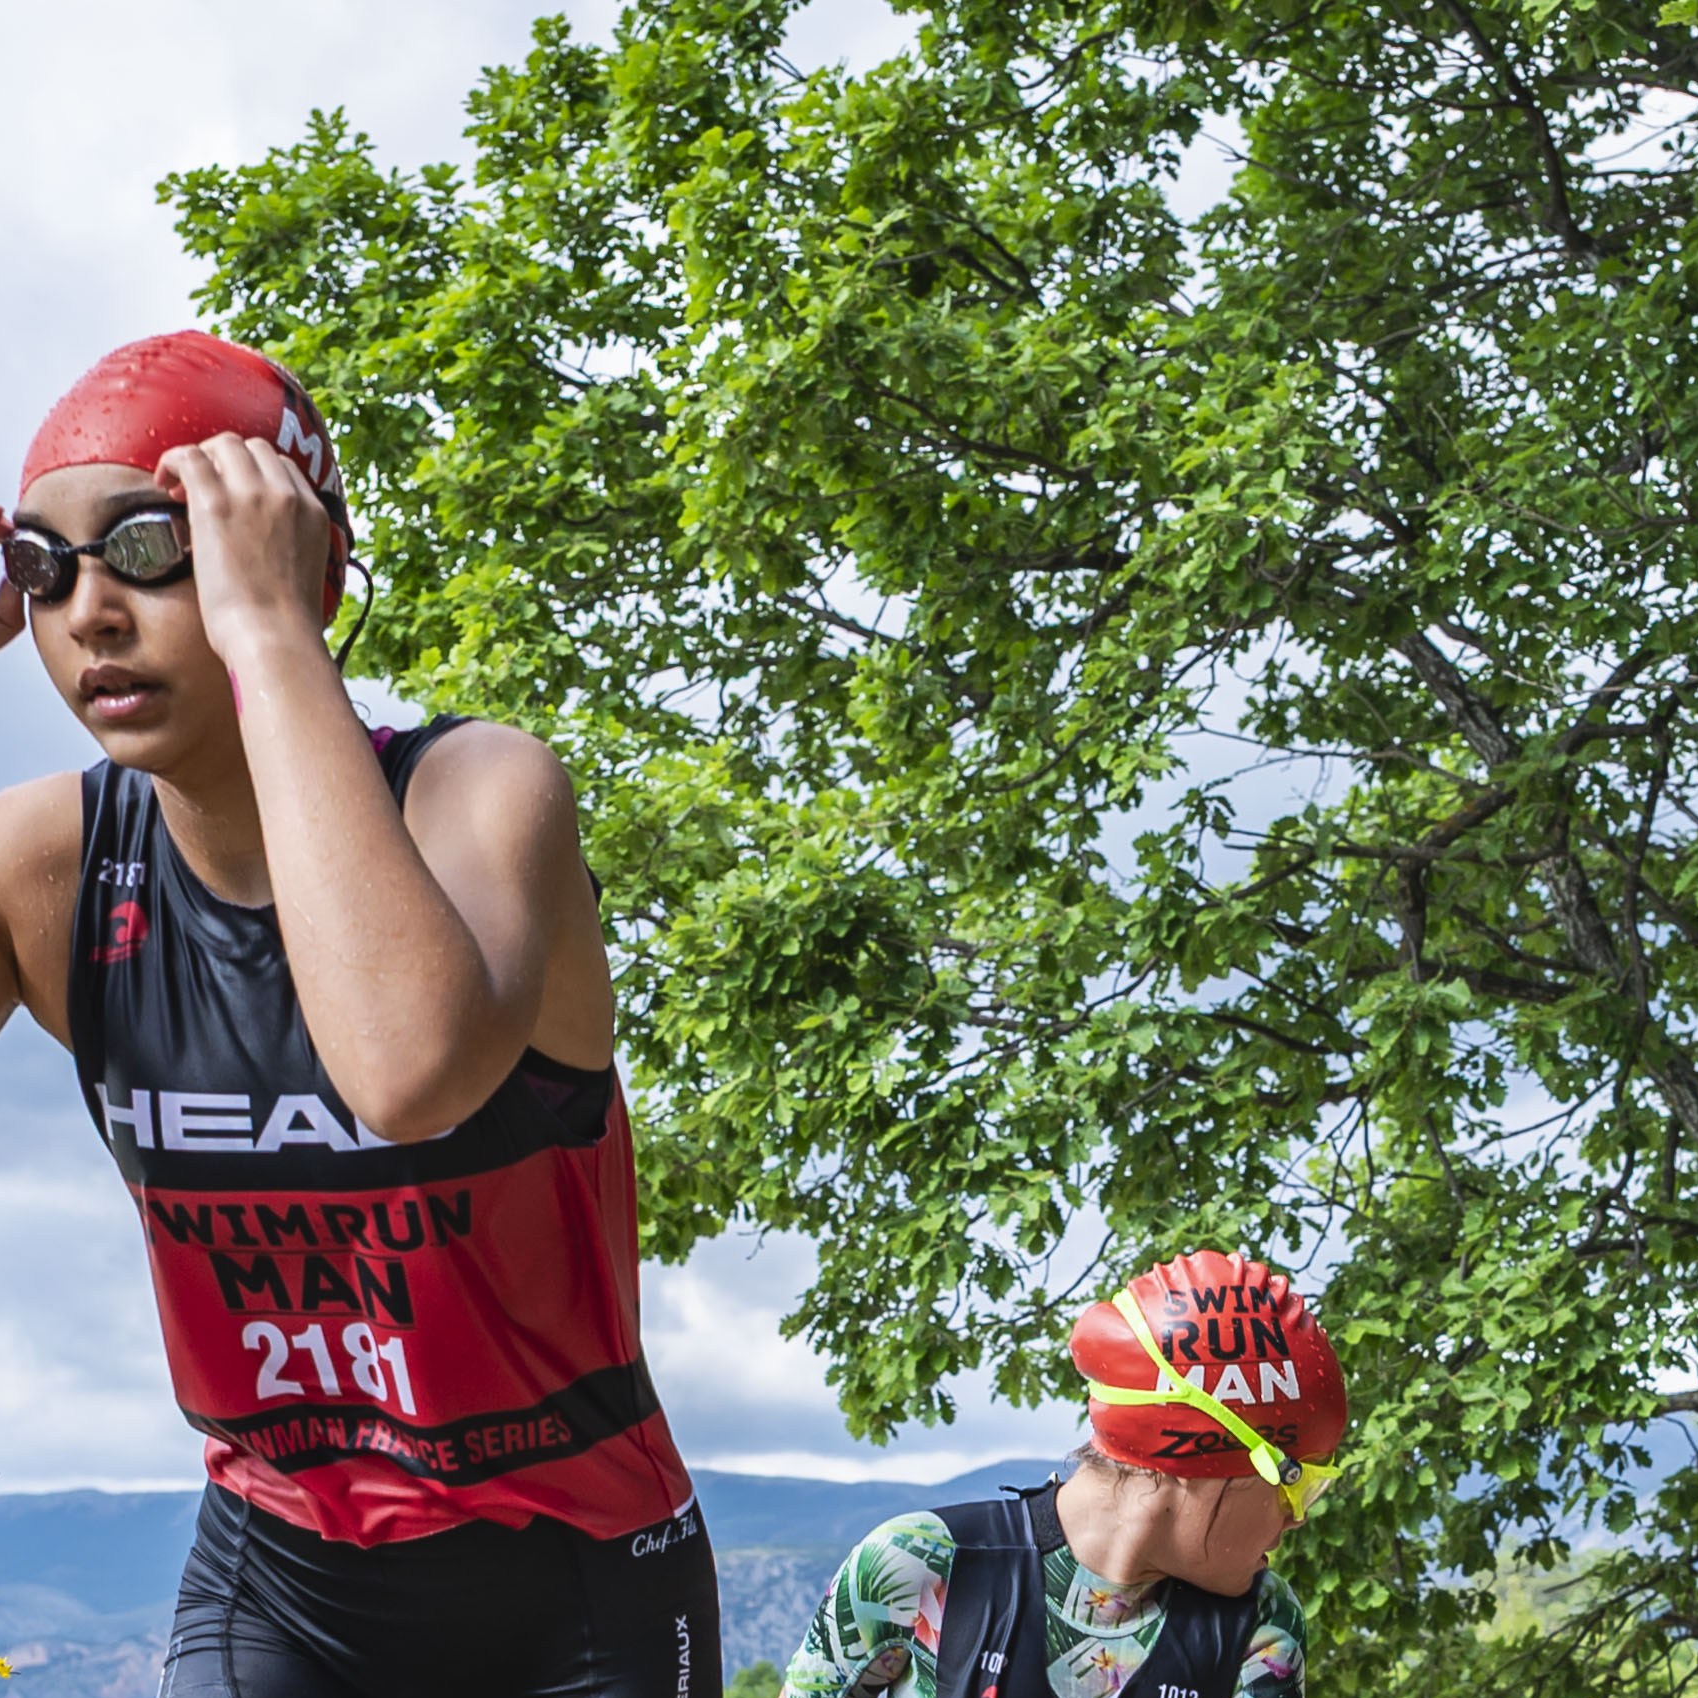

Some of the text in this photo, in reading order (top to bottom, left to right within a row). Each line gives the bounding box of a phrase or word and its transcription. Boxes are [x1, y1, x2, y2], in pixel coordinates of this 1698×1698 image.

[144, 1189, 472, 1252] WIMRUN
[209, 1251, 415, 1324] MAN
[1164, 1285, 1278, 1316] SWIM
[1161, 1316, 1290, 1362] RUN
[242, 1321, 417, 1416] 2181
[1155, 1359, 1301, 1407] MAN
[464, 1410, 572, 1465] SERIES
